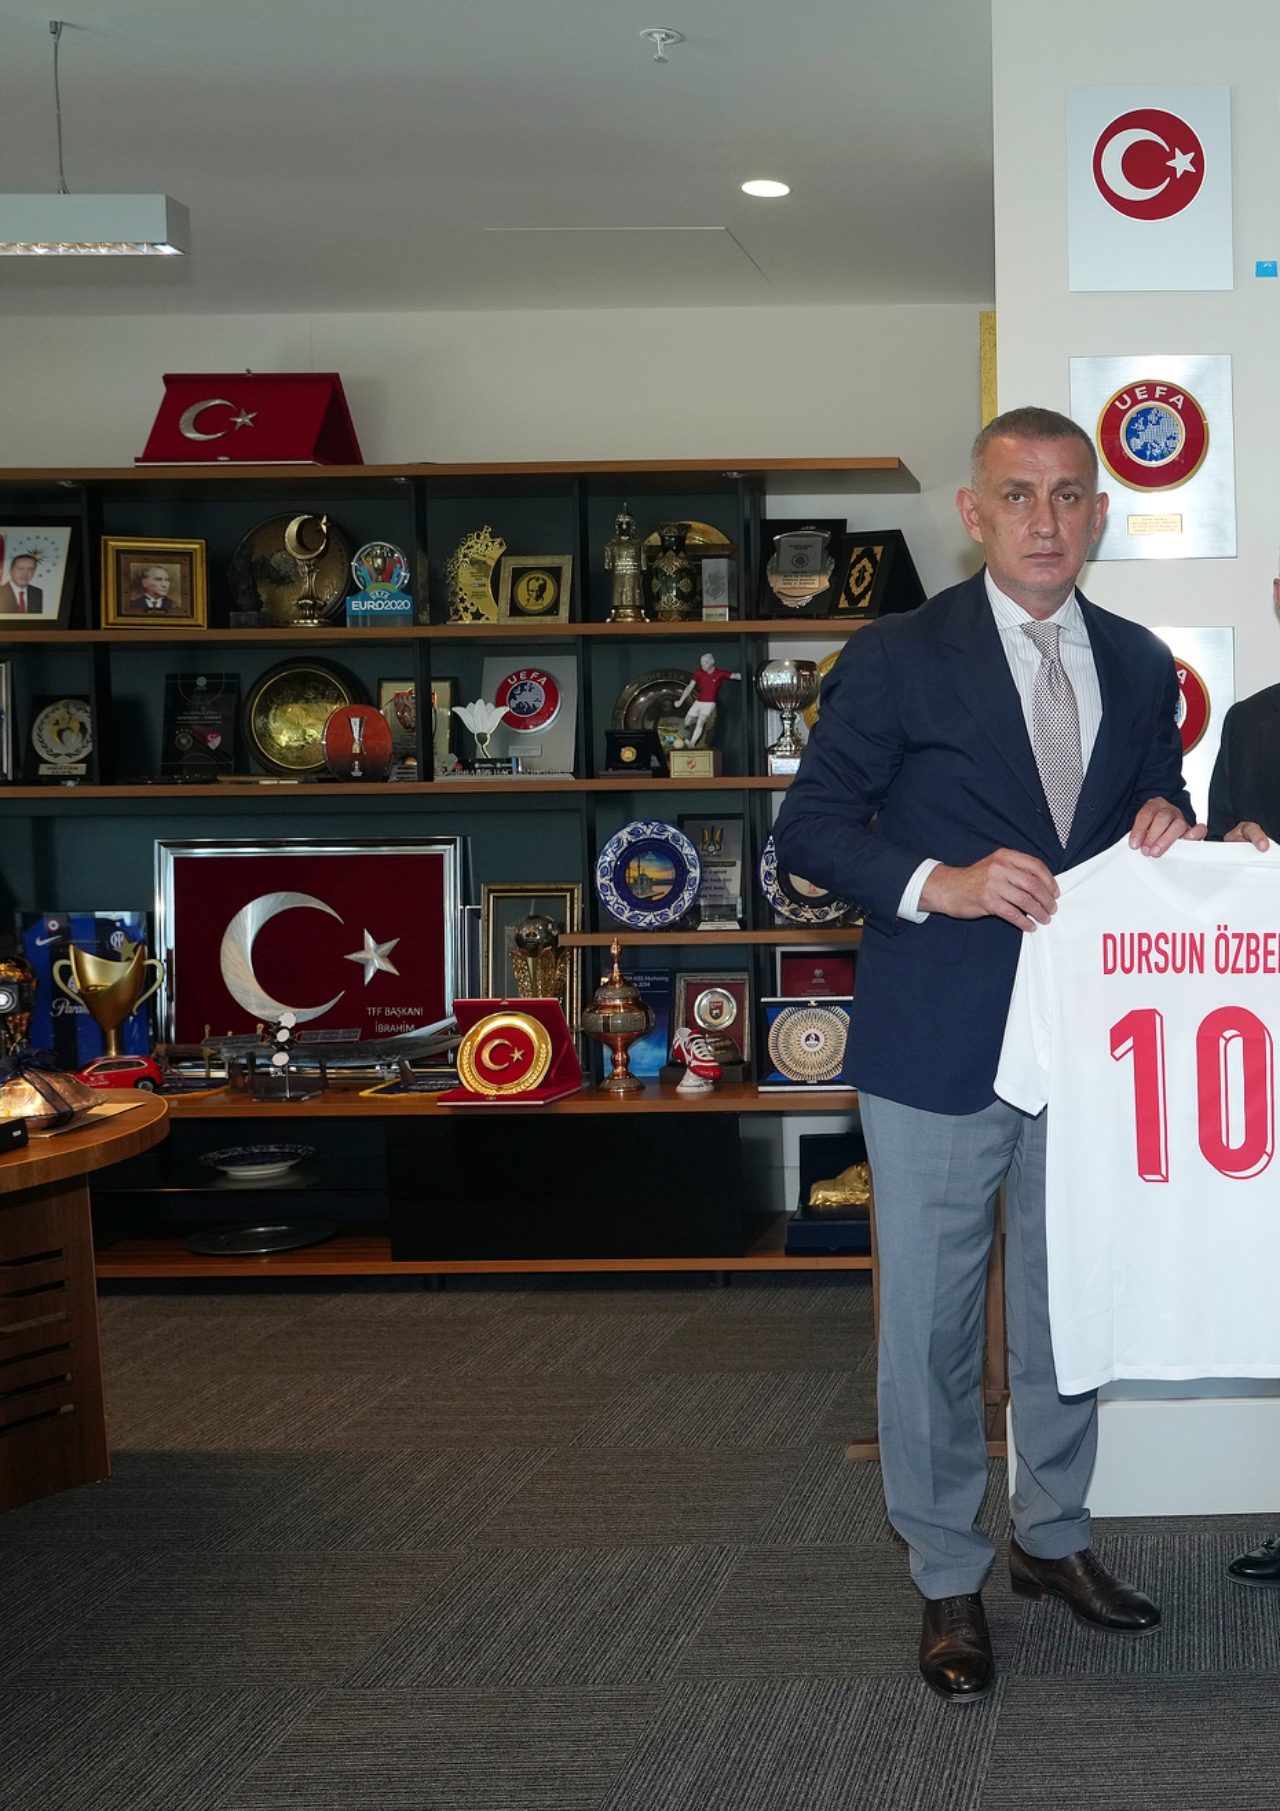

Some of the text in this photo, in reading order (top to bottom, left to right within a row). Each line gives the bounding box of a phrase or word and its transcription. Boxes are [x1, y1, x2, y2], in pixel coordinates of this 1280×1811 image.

[1114, 386, 1185, 410] UEFA
[352, 600, 411, 611] EURO2020
[507, 671, 547, 686] UEFA
[1102, 932, 1205, 975] DURSUN
[367, 1007, 424, 1019] TFF BAŞKANI
[375, 1020, 415, 1033] İBRAHİM
[1109, 1005, 1275, 1184] 10
